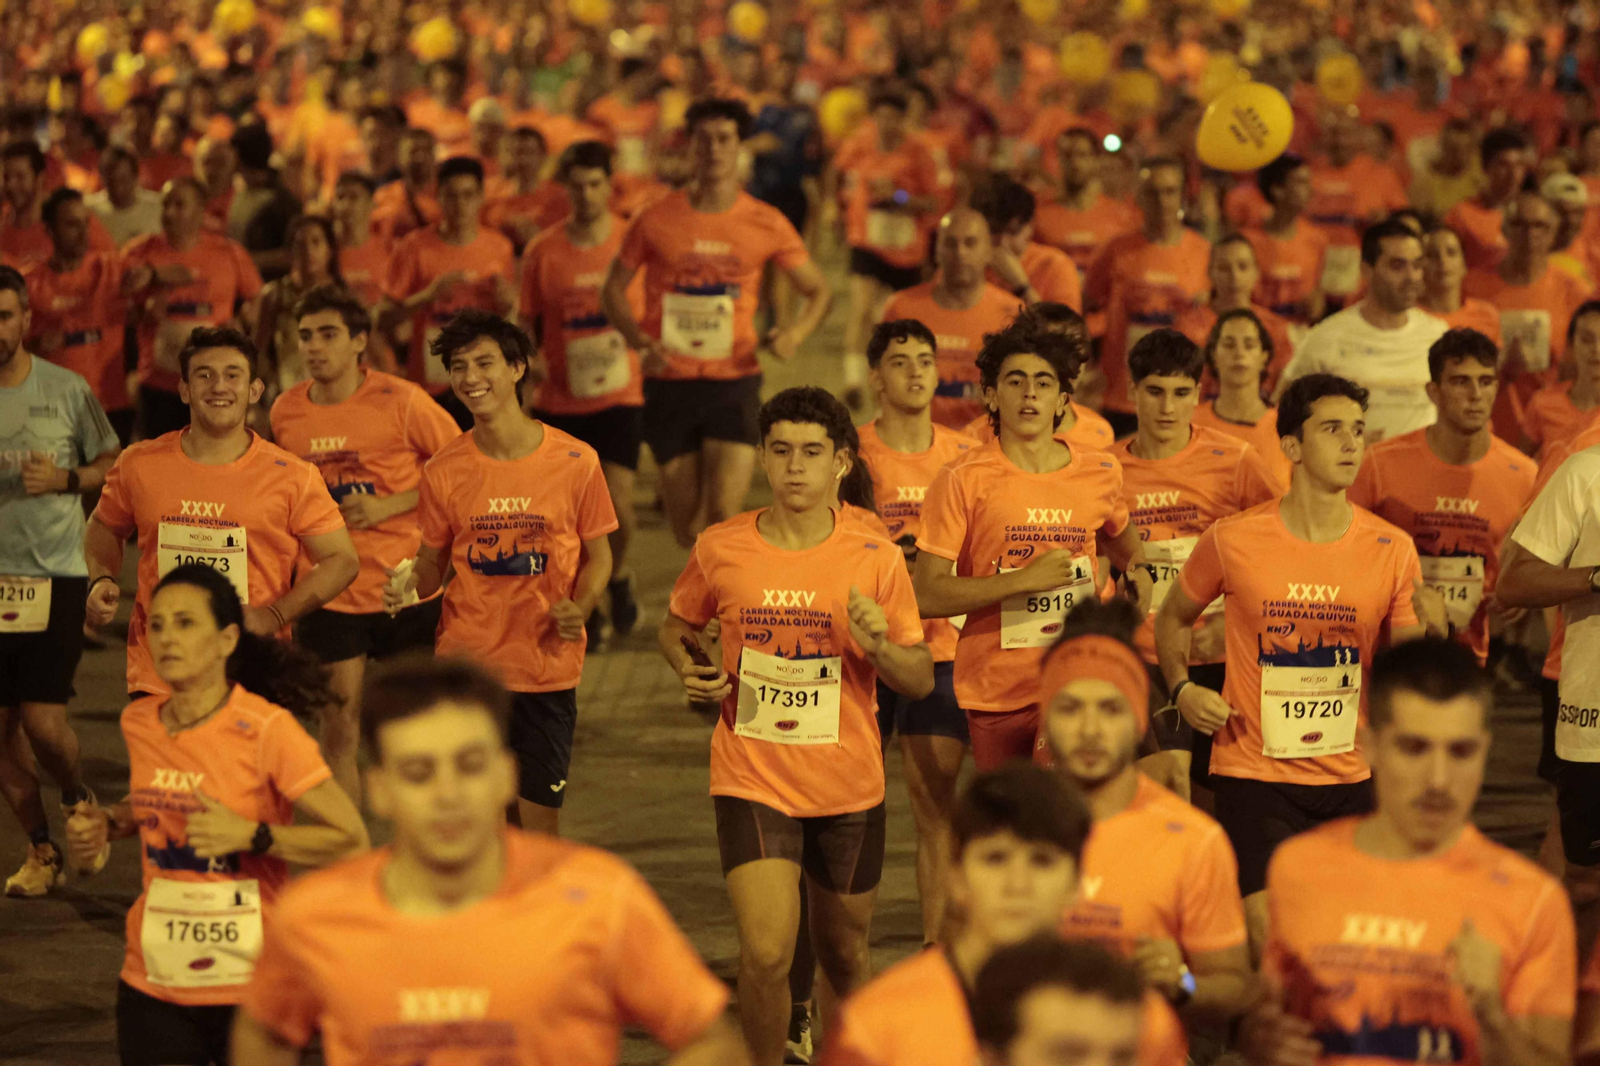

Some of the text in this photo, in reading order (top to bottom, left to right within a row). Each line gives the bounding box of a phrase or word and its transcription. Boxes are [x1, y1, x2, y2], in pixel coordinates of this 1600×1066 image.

[310, 436, 347, 454] XXXV
[897, 486, 928, 502] XXX
[1135, 490, 1180, 509] XXXV
[180, 500, 226, 518] XXXV
[487, 497, 532, 514] XXXV
[161, 515, 196, 524] CARRERA
[198, 518, 240, 527] NOCTURNA
[470, 513, 546, 523] CARRERA NOCTURNA
[1026, 508, 1073, 524] XXXV
[1132, 512, 1199, 526] UADALQUIVIR
[475, 521, 546, 531] GUADALQUIVIR
[1046, 526, 1087, 534] NOCTURNA
[1011, 533, 1086, 543] GUADALQUIVIR
[762, 589, 816, 608] XXXV
[1286, 582, 1341, 603] XXXV
[1027, 592, 1074, 613] 5918
[1262, 600, 1357, 613] CARRERA NOCTURNA
[740, 607, 833, 619] CARRERA NOCTURNA
[1268, 608, 1357, 623] GUADALQUIVIR
[745, 616, 833, 629] GUADALQUIVIR
[758, 685, 819, 708] 17391
[1281, 699, 1344, 719] 19720
[150, 768, 205, 792] XXXV
[165, 919, 240, 943] 17656
